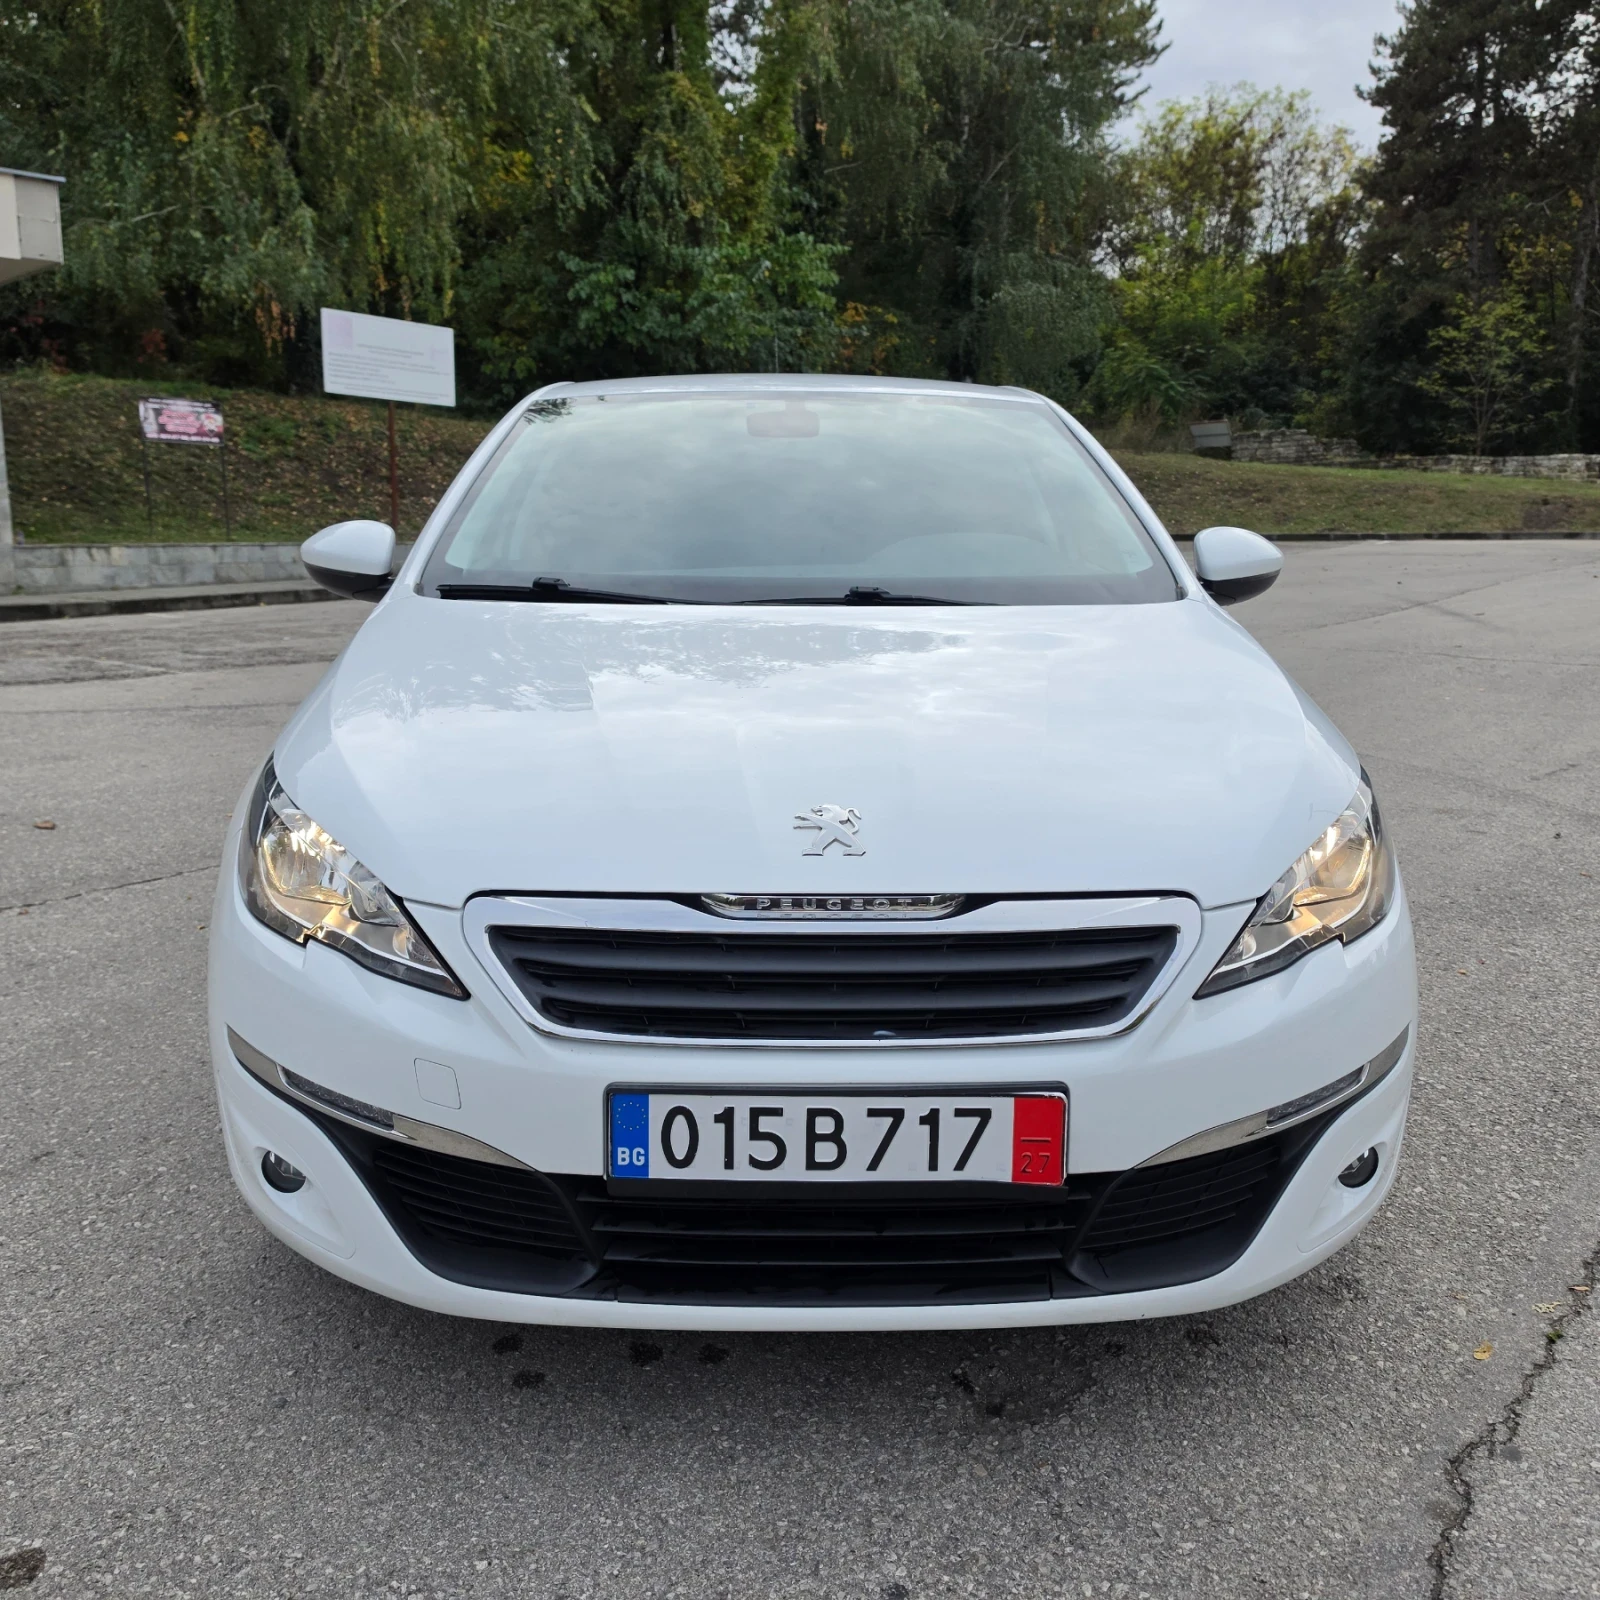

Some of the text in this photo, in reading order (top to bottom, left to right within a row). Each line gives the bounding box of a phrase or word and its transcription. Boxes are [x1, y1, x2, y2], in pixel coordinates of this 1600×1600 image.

[756, 898, 912, 910] PEUGEOT
[617, 1146, 646, 1166] BG
[1020, 1151, 1051, 1174] 27
